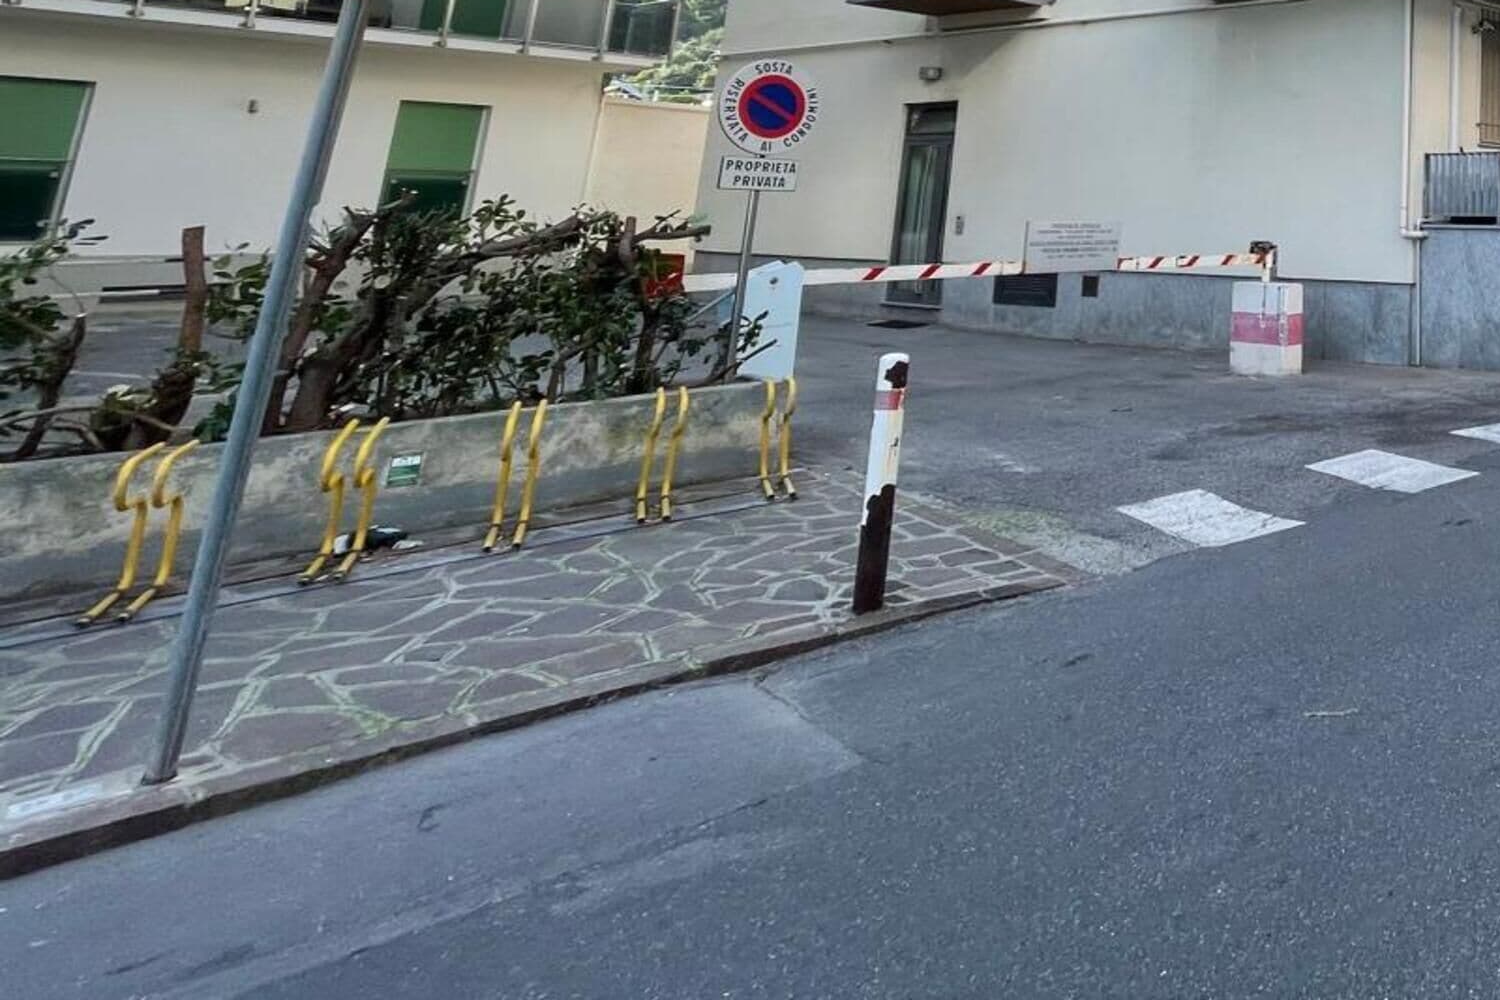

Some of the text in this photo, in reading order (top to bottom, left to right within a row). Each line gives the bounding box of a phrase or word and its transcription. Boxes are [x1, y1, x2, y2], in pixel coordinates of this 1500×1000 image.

[755, 61, 793, 74] SOSTA
[723, 78, 749, 143] RISERVATA
[783, 87, 818, 147] CONDOMINI
[760, 142, 772, 153] AI
[732, 175, 785, 188] PRIVATA
